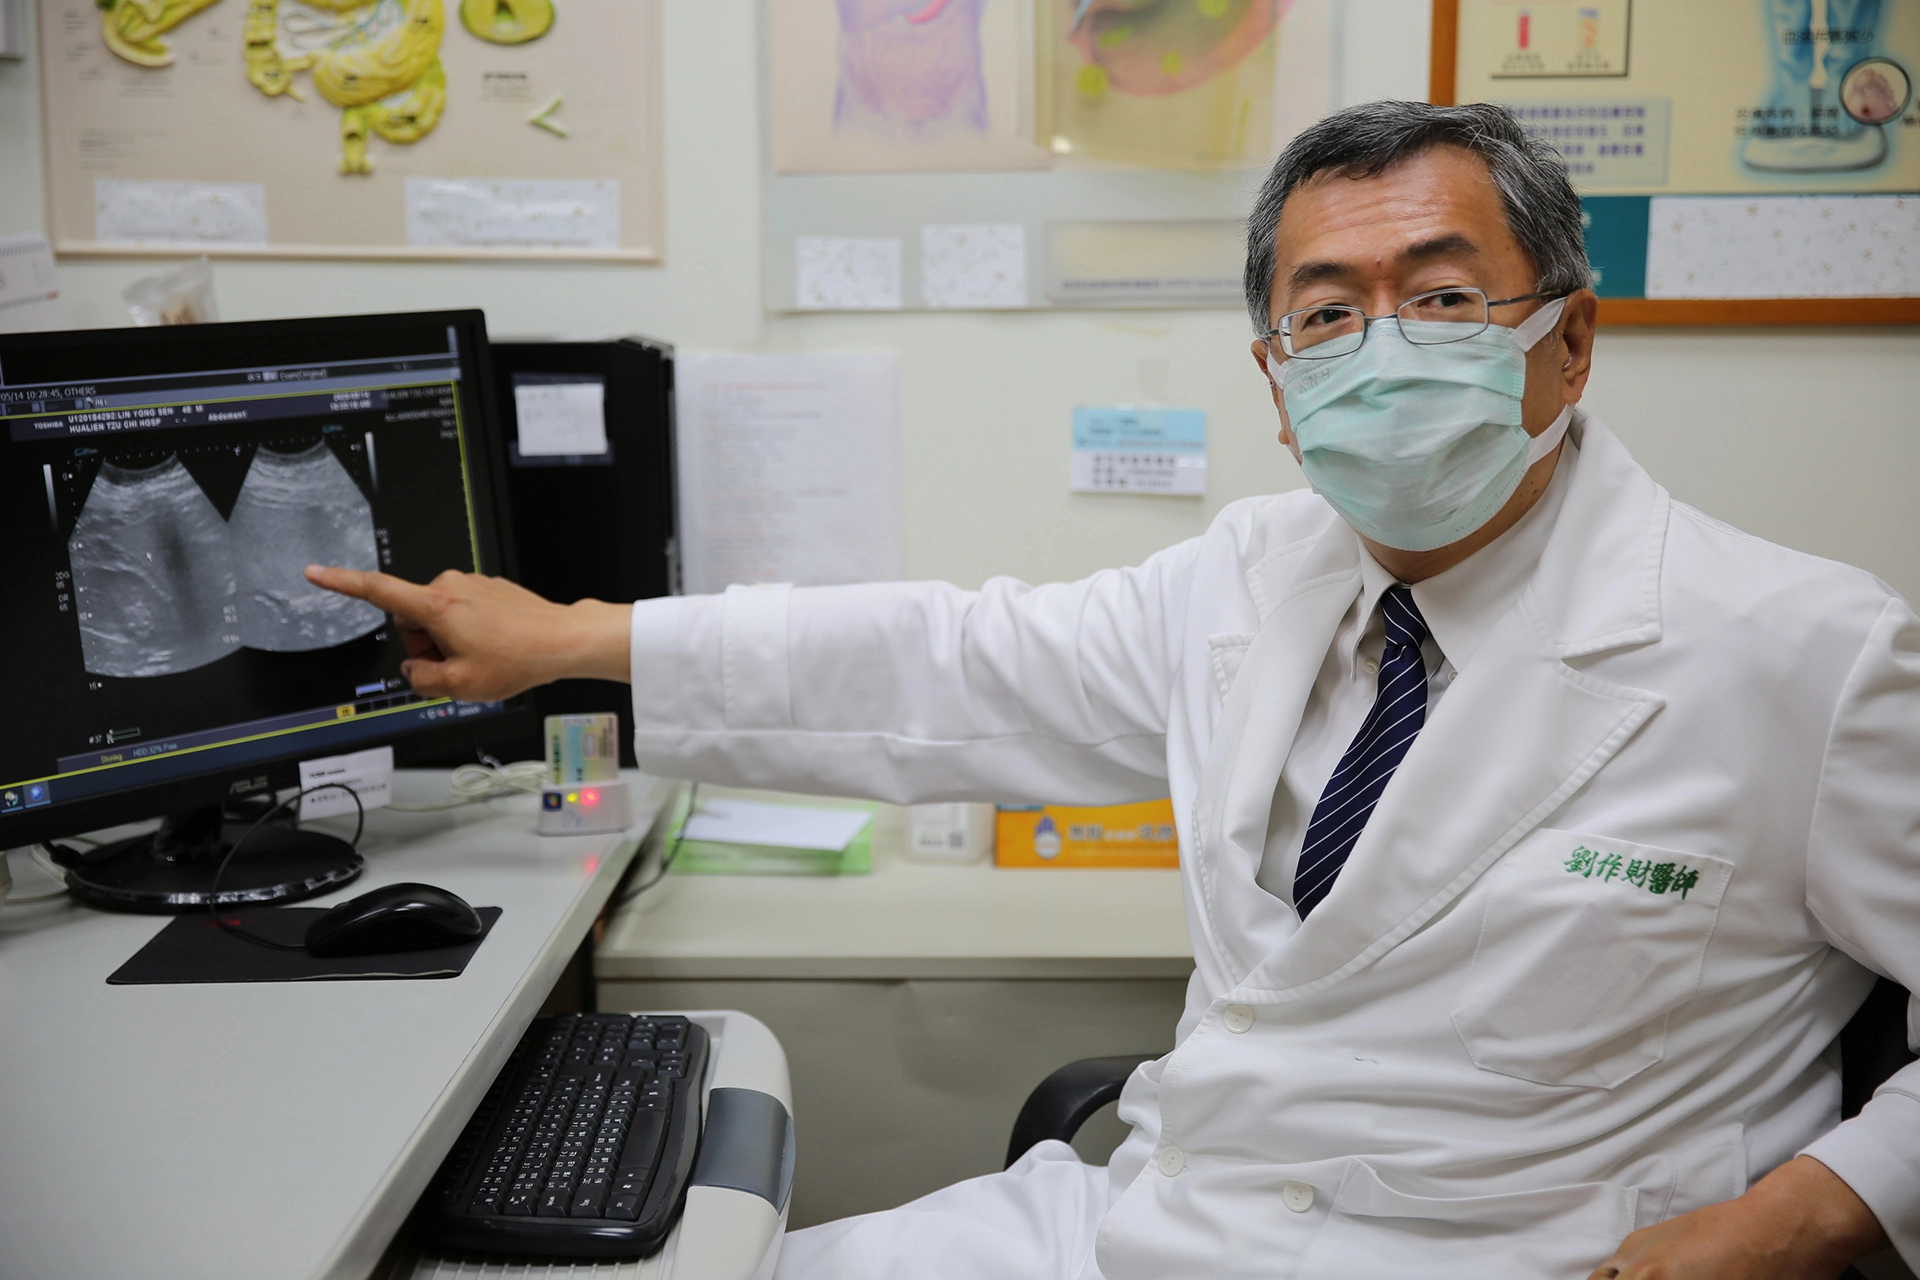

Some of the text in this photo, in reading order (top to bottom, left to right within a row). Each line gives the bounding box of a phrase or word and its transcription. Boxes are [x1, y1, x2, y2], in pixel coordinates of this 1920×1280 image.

[64, 386, 96, 397] OTHERS
[33, 420, 64, 431] TOSHIBA
[69, 417, 161, 434] HUALIEN TZU CHI HOSP
[228, 775, 268, 795] ASUS
[1563, 845, 1699, 900] 劉作財醫師
